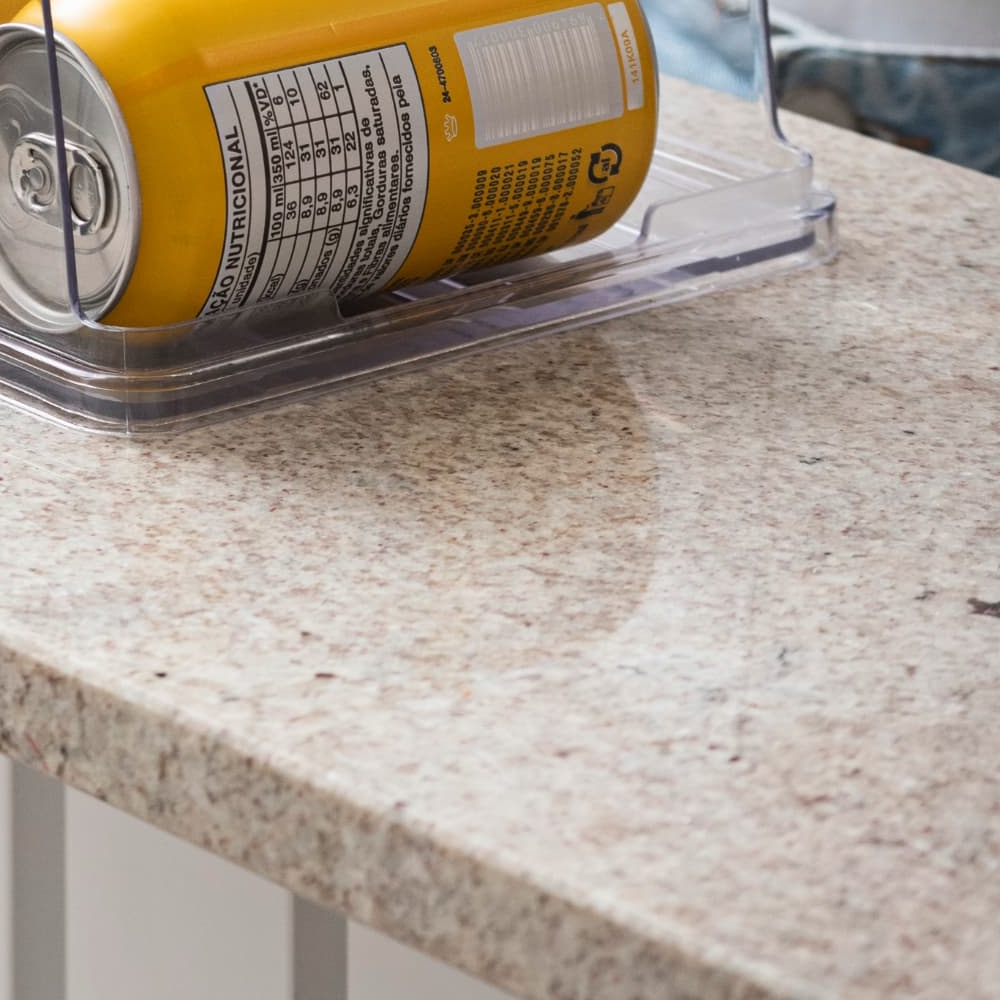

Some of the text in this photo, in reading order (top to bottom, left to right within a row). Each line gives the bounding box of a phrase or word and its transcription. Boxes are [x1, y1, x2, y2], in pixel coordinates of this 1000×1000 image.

[272, 96, 283, 106] 6
[317, 81, 332, 101] 62
[389, 75, 412, 109] pela
[361, 66, 388, 146] saturadas,
[359, 118, 373, 137] de
[266, 132, 283, 152] ml
[286, 89, 314, 219] 8,9 31 10
[314, 140, 326, 159] 31
[329, 136, 342, 156] 31
[344, 130, 357, 153] 22
[399, 113, 414, 193] fornecidos
[283, 141, 296, 169] 124
[271, 153, 284, 185] 350
[225, 126, 245, 268] NUTRICIONAL
[271, 187, 284, 207] ml
[346, 185, 360, 209] 6,3
[359, 148, 376, 237] significativas
[372, 150, 389, 220] Gorduras
[285, 201, 298, 221] 36
[316, 192, 329, 216] 8,9
[331, 189, 345, 213] 8,9
[363, 150, 401, 275] Fibras alimentares.
[270, 212, 283, 239] 100
[388, 197, 412, 242] diários
[325, 227, 341, 246] (g)
[359, 223, 383, 260] totais,
